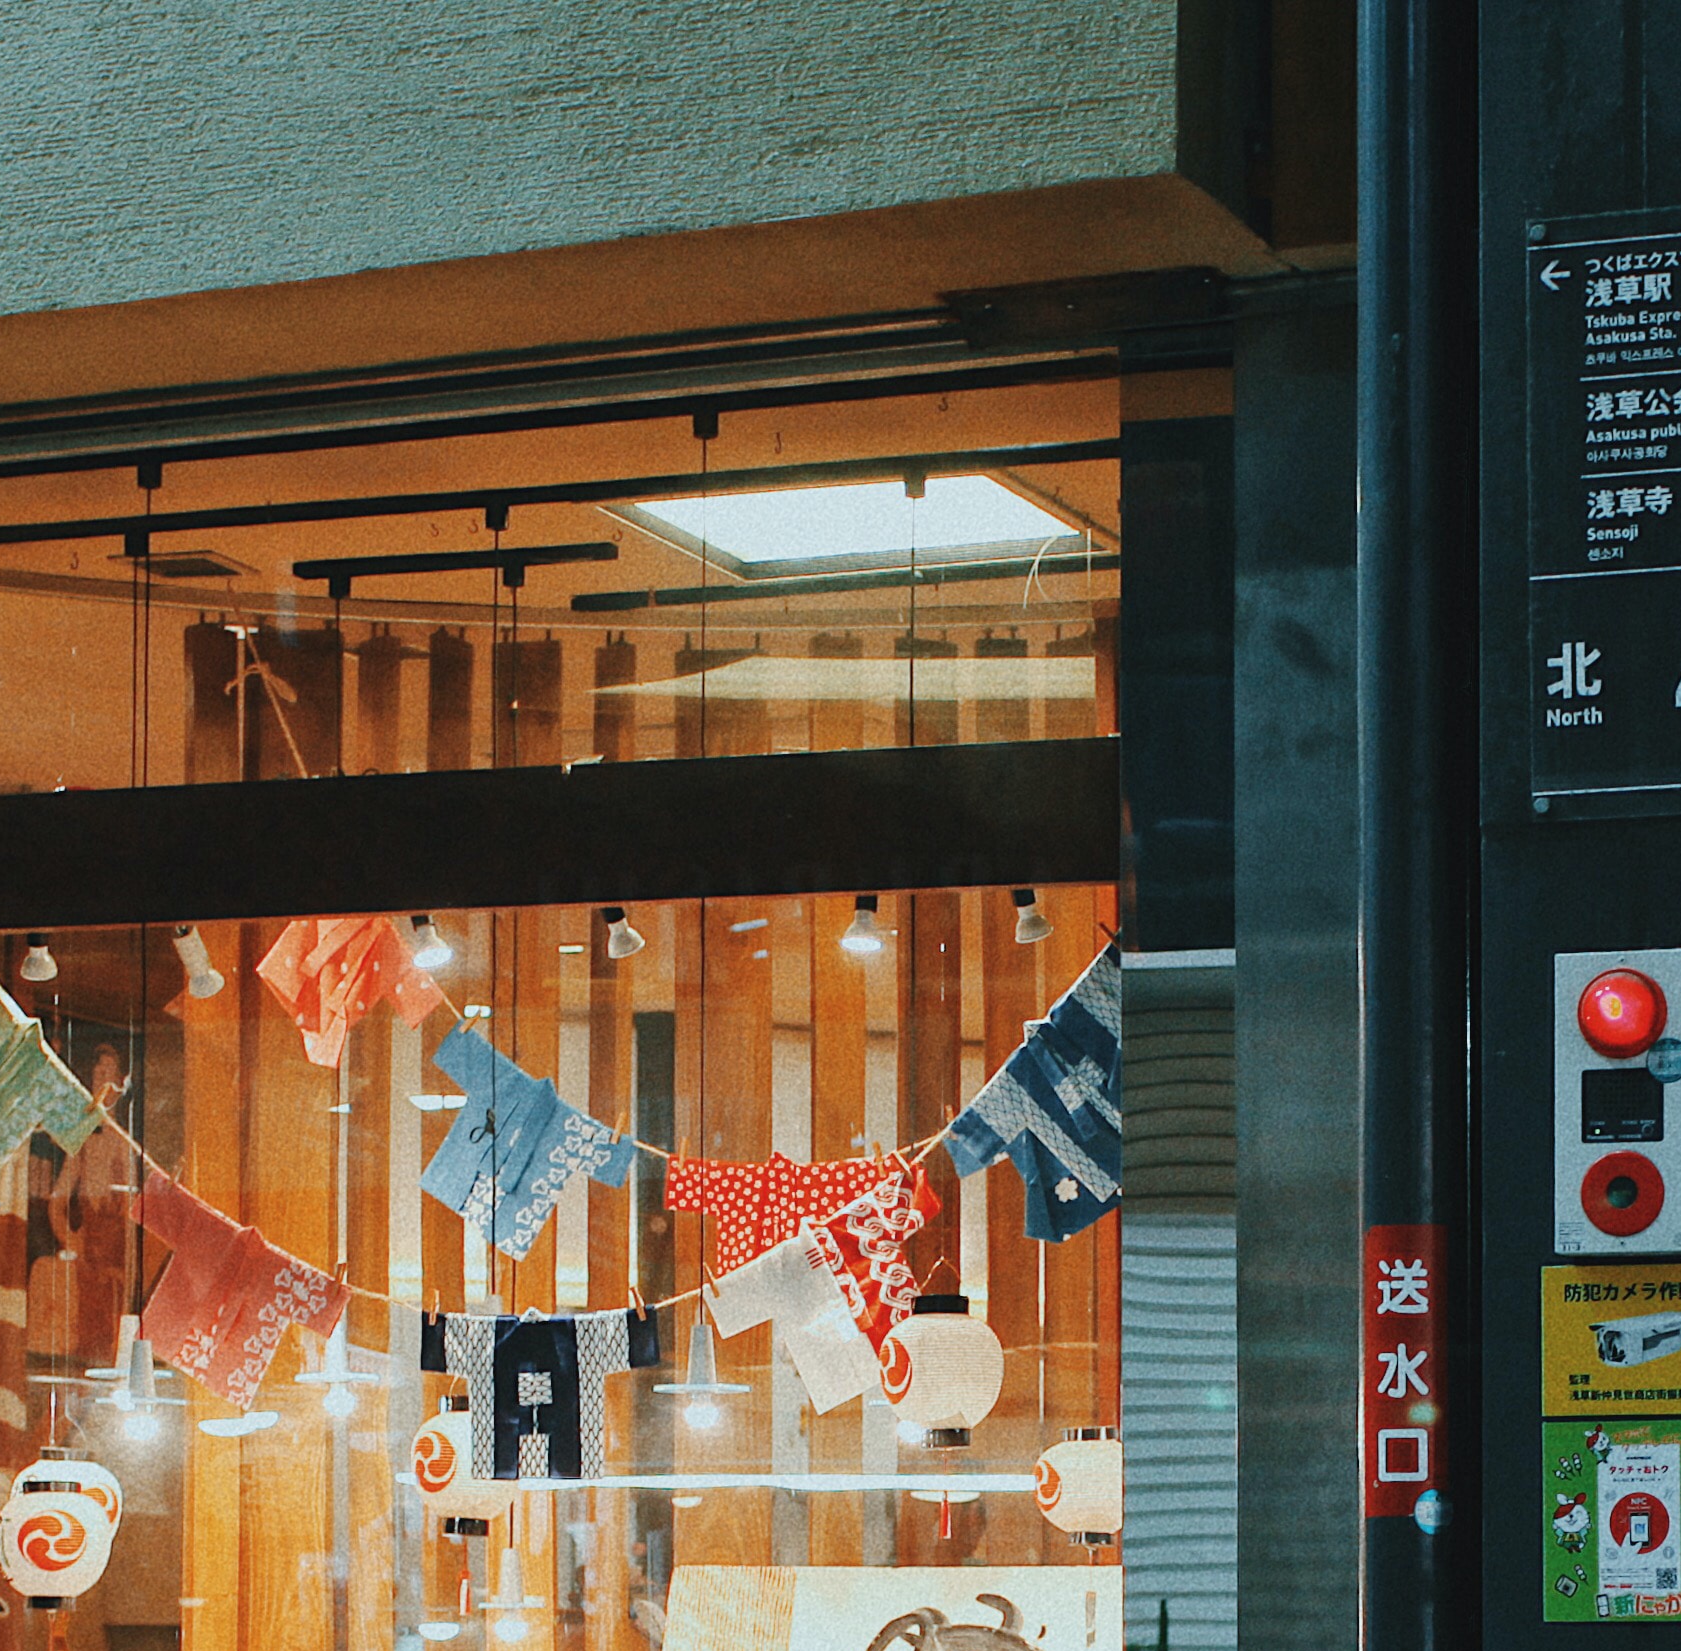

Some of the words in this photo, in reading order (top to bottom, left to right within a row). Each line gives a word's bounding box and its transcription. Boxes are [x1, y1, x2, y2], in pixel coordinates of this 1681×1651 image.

[1584, 272, 1672, 308] 浅草駅
[1585, 313, 1635, 329] Tskuba
[1585, 330, 1646, 346] Asakusa
[1649, 326, 1677, 341] Sta.
[1585, 425, 1647, 444] Asakusa
[1586, 486, 1673, 520] 浅草寺
[1586, 524, 1639, 542] Sensoji
[1546, 641, 1602, 699] 北
[1546, 706, 1603, 728] North
[1376, 1258, 1430, 1483] 送水口
